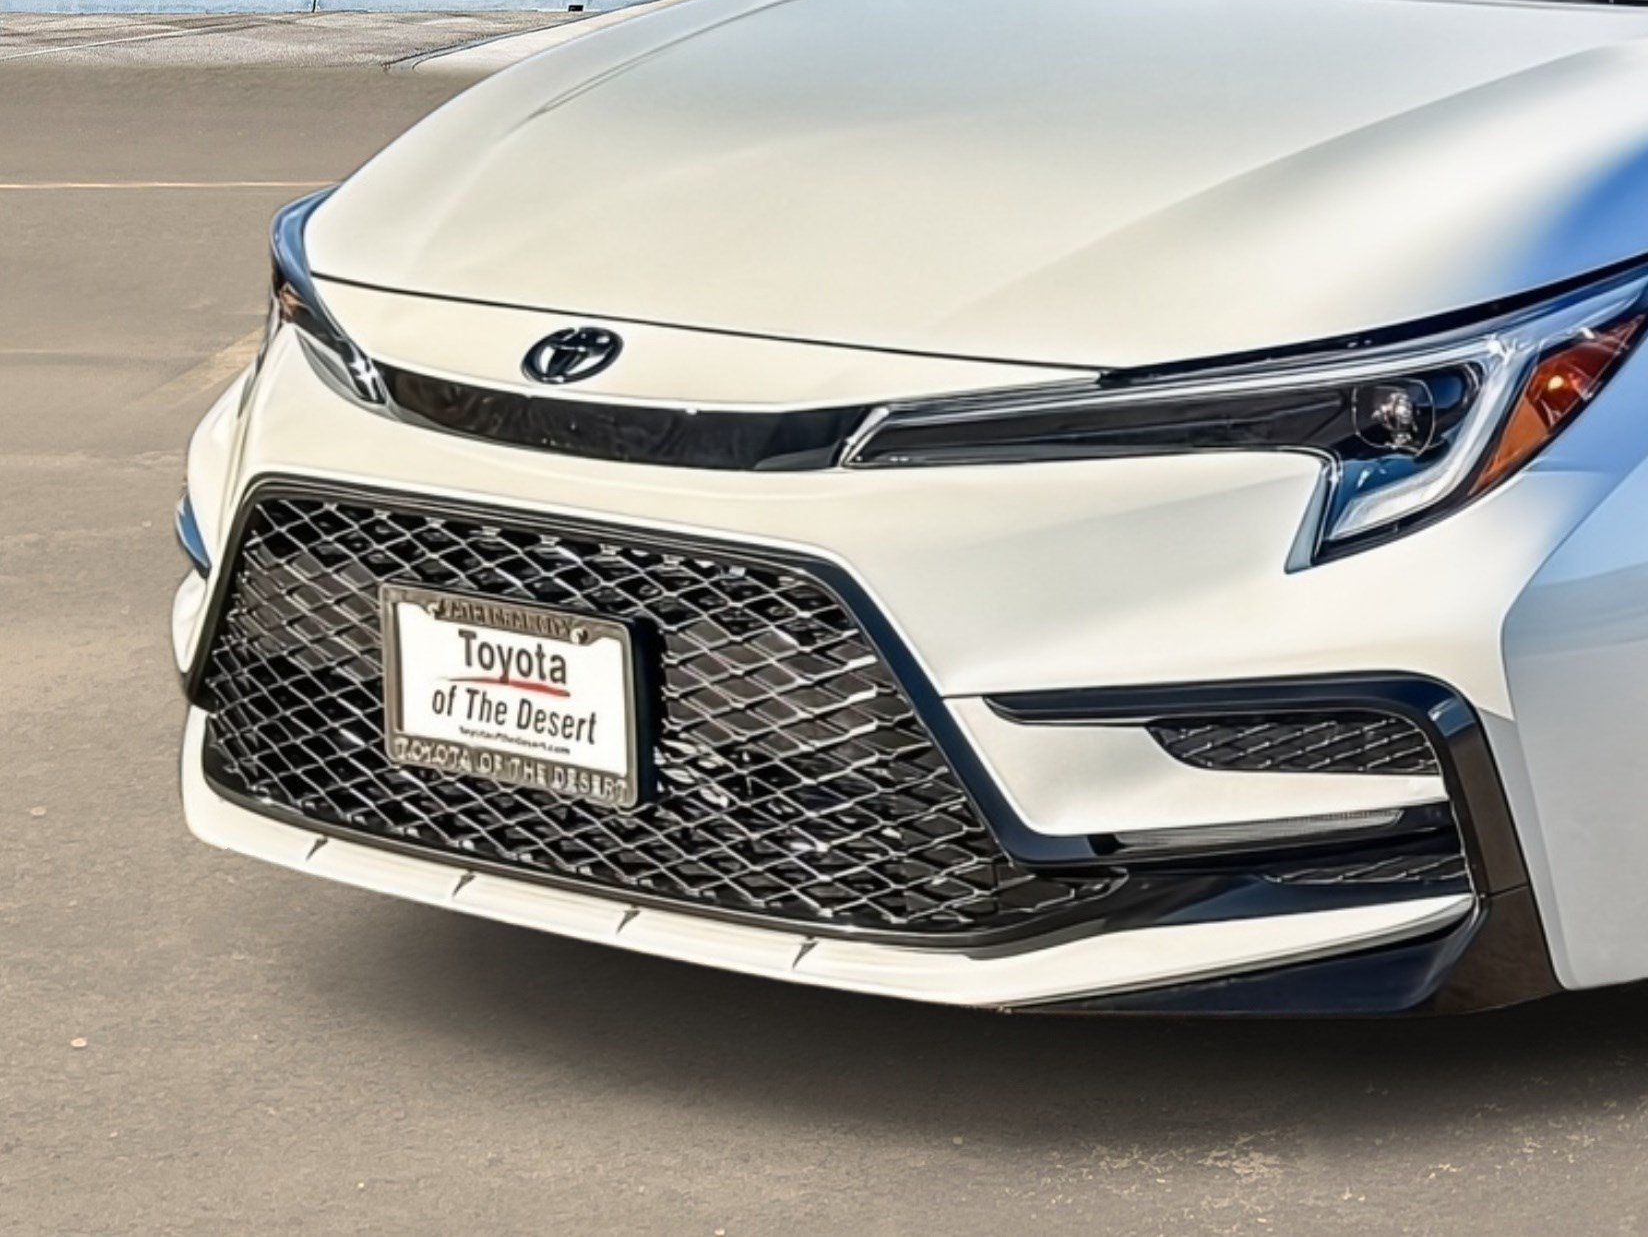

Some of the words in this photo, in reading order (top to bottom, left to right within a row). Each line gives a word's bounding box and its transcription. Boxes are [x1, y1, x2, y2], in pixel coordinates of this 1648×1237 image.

[458, 629, 568, 684] Toyota
[432, 684, 457, 717] of
[465, 688, 508, 726] The
[517, 698, 597, 745] Desert
[393, 737, 471, 773] TOYOTA
[477, 752, 502, 776] OF
[508, 758, 548, 786] THE
[552, 765, 628, 803] DESERT
